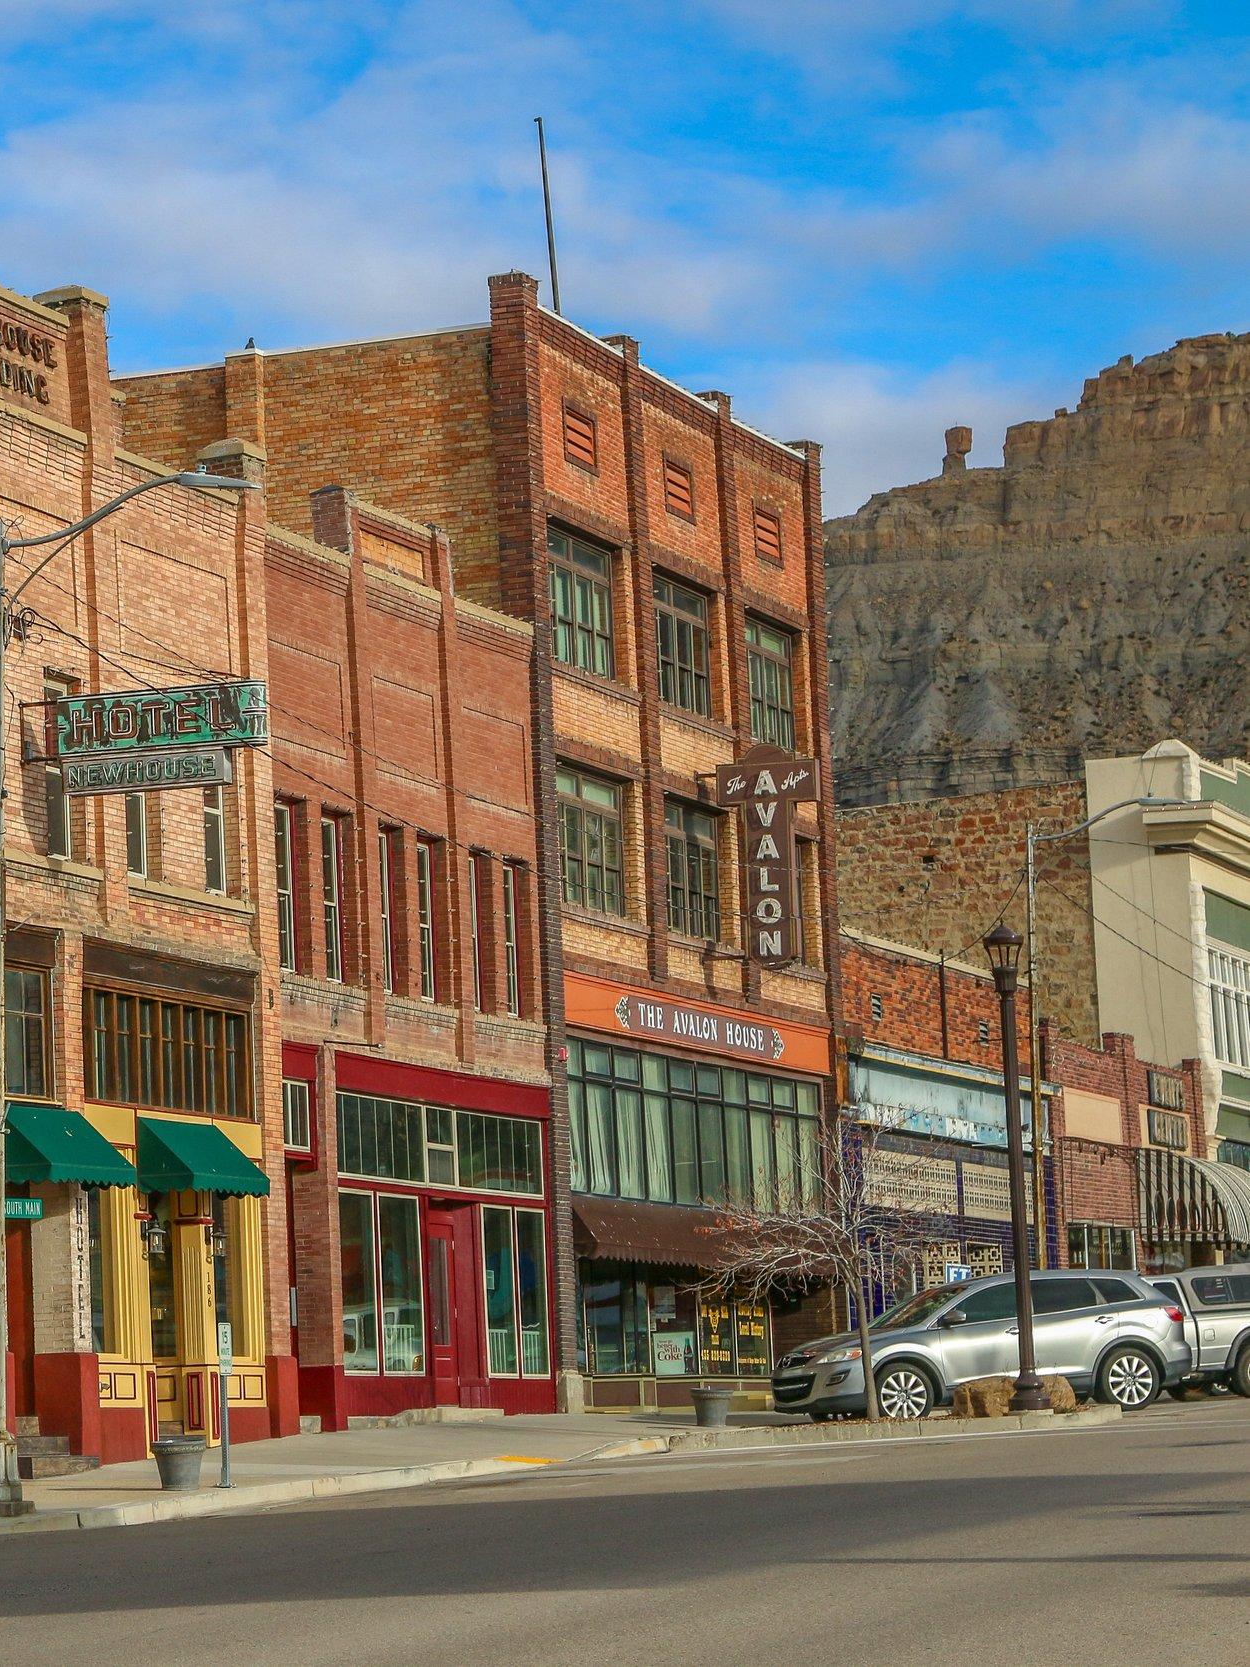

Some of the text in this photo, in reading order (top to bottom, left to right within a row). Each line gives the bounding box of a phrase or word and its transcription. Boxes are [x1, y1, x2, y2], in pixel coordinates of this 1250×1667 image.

[70, 696, 236, 744] HOTEL
[67, 754, 217, 788] NEWHOUSE
[726, 774, 747, 795] The
[753, 769, 782, 956] AVALON
[638, 1002, 765, 1051] THE AVALON HOUSE
[25, 1201, 41, 1215] MAIN
[658, 1351, 683, 1361] Coke
